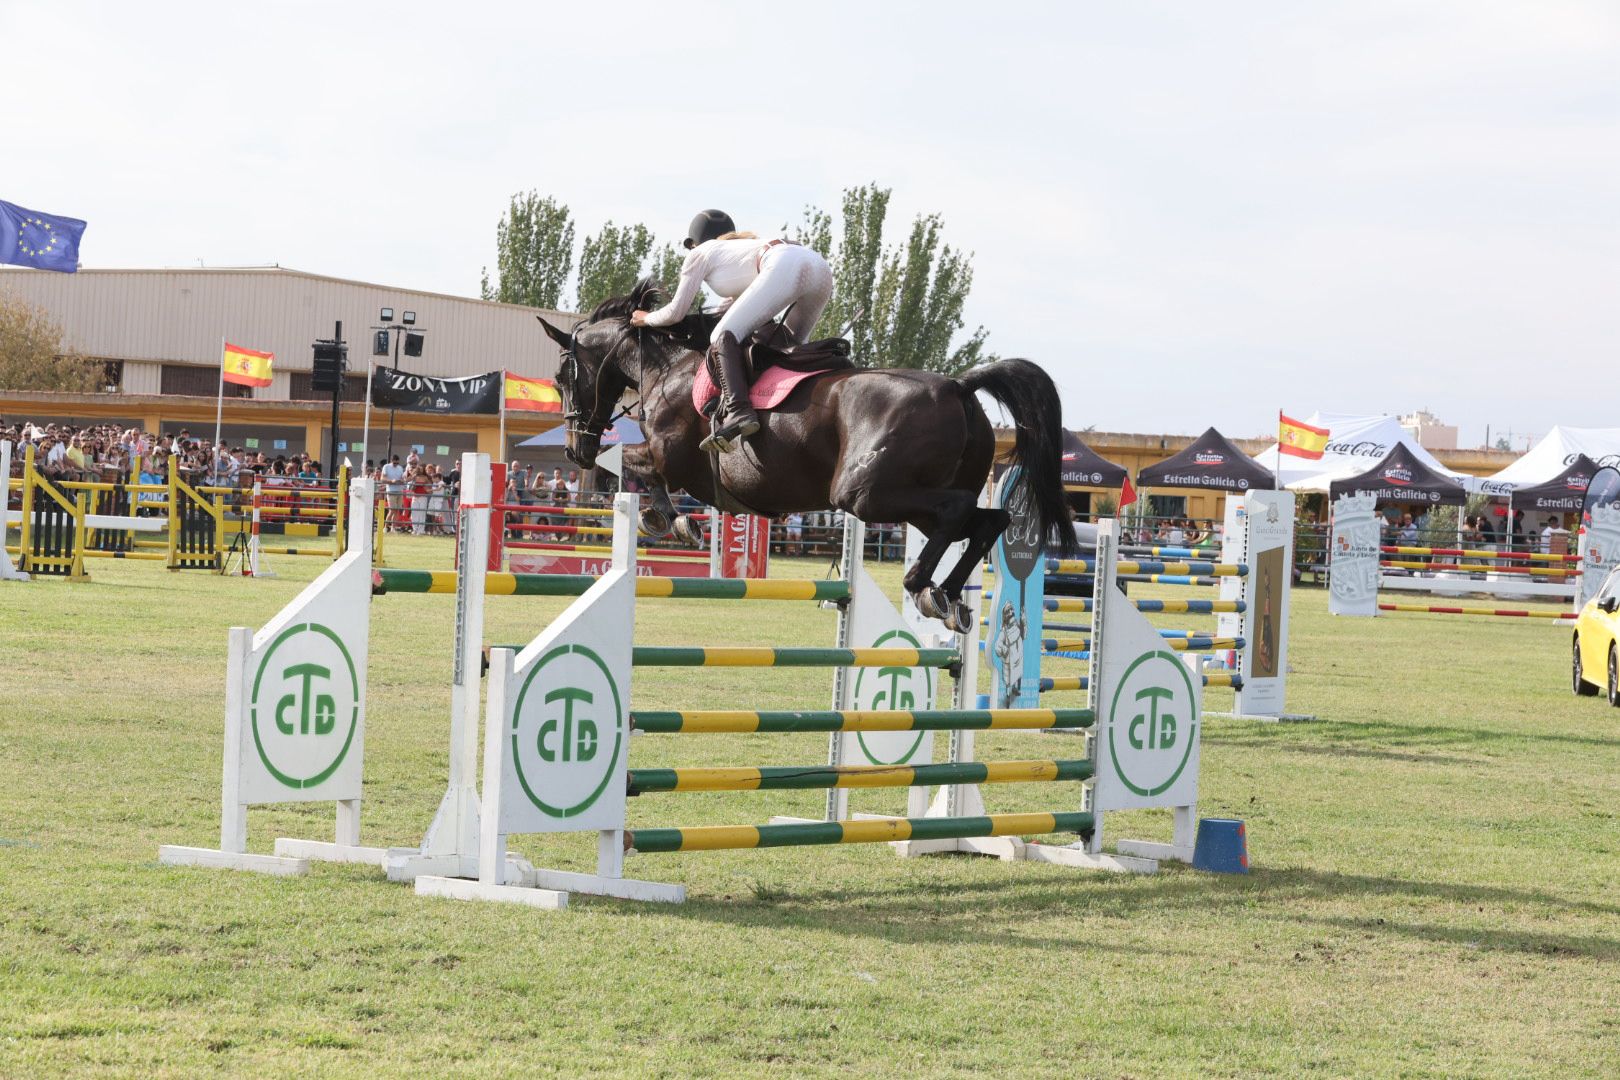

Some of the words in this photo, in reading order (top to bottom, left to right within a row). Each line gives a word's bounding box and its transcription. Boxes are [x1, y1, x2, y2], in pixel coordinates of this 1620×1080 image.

[391, 374, 448, 394] ZONA
[458, 379, 487, 394] VIP
[1325, 440, 1387, 458] oca-Cola
[1163, 474, 1200, 484] Estrella
[1201, 475, 1235, 487] Galicia
[1393, 488, 1427, 500] Galicia
[1536, 497, 1574, 508] Estrella
[729, 534, 745, 553] LA
[580, 559, 600, 576] LA
[275, 662, 336, 736] CTD
[536, 687, 598, 762] CTD
[1128, 686, 1177, 750] CTD
